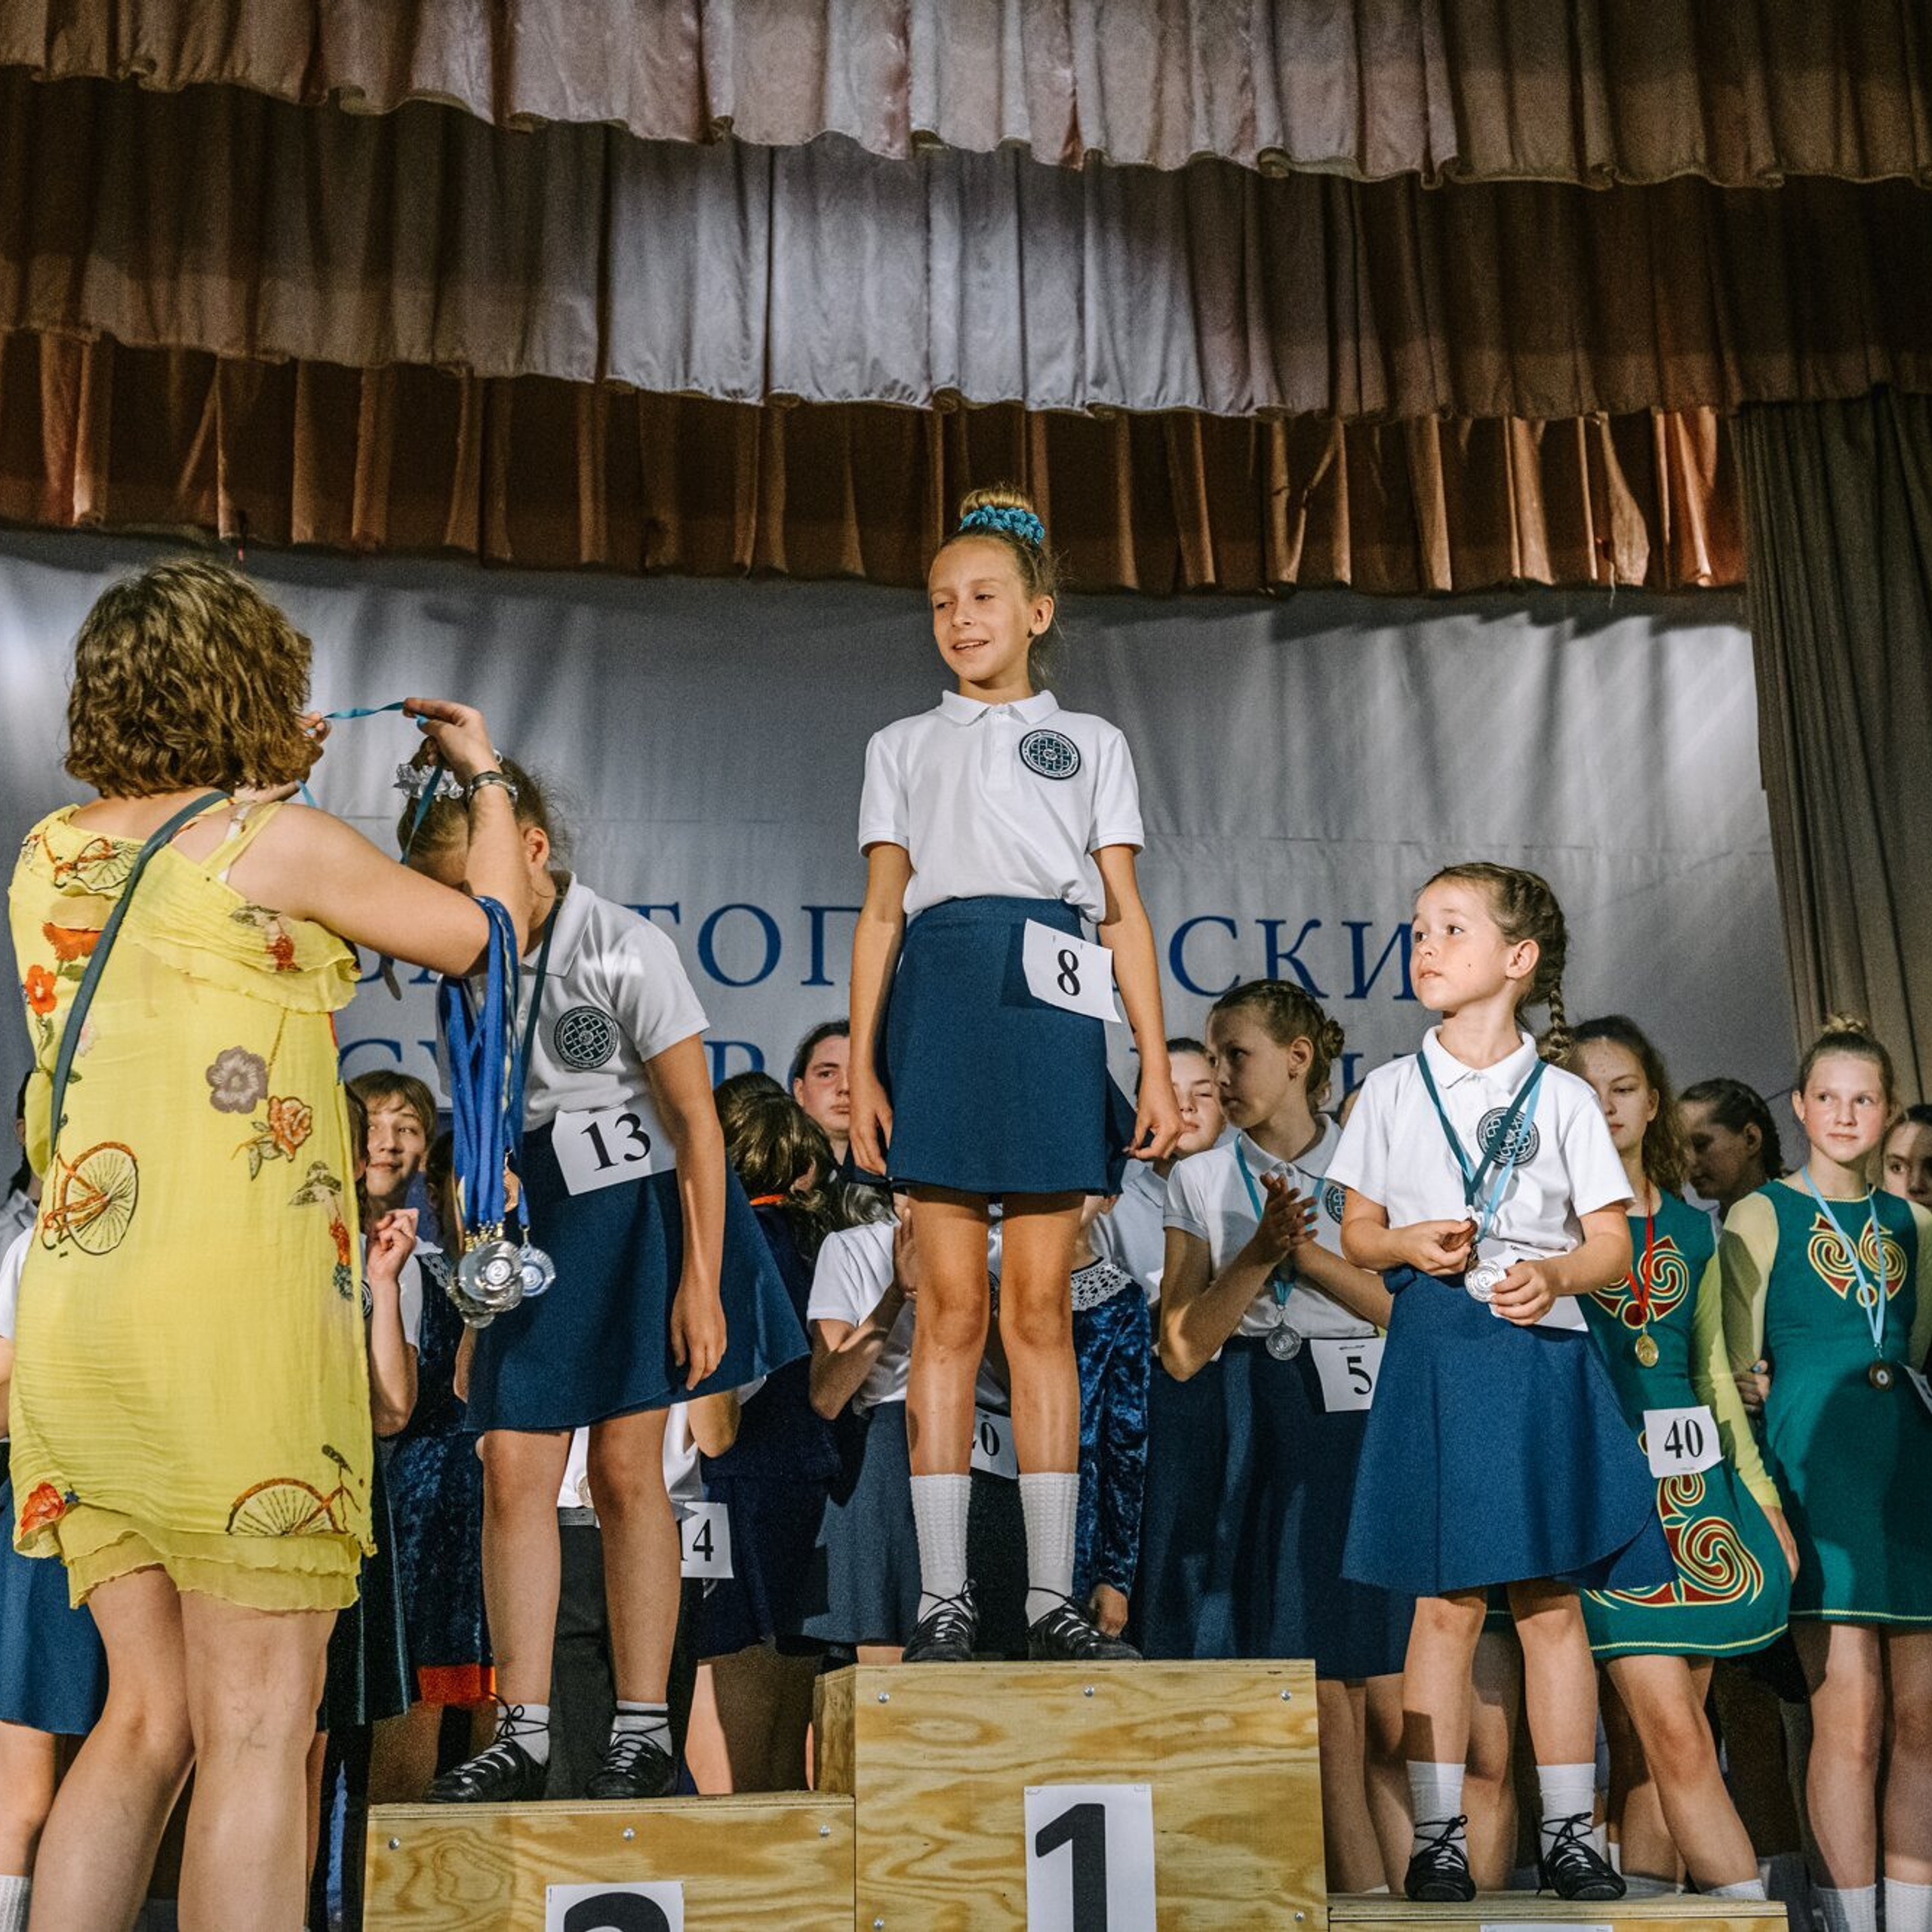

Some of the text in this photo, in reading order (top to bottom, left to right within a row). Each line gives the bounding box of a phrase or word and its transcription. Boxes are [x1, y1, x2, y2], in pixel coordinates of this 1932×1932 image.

[1057, 949, 1081, 996] 8
[580, 1113, 651, 1172] 13
[1346, 1356, 1373, 1395] 5
[972, 1423, 1000, 1457] 0
[1664, 1419, 1703, 1459] 40
[1035, 1803, 1108, 1932] 1
